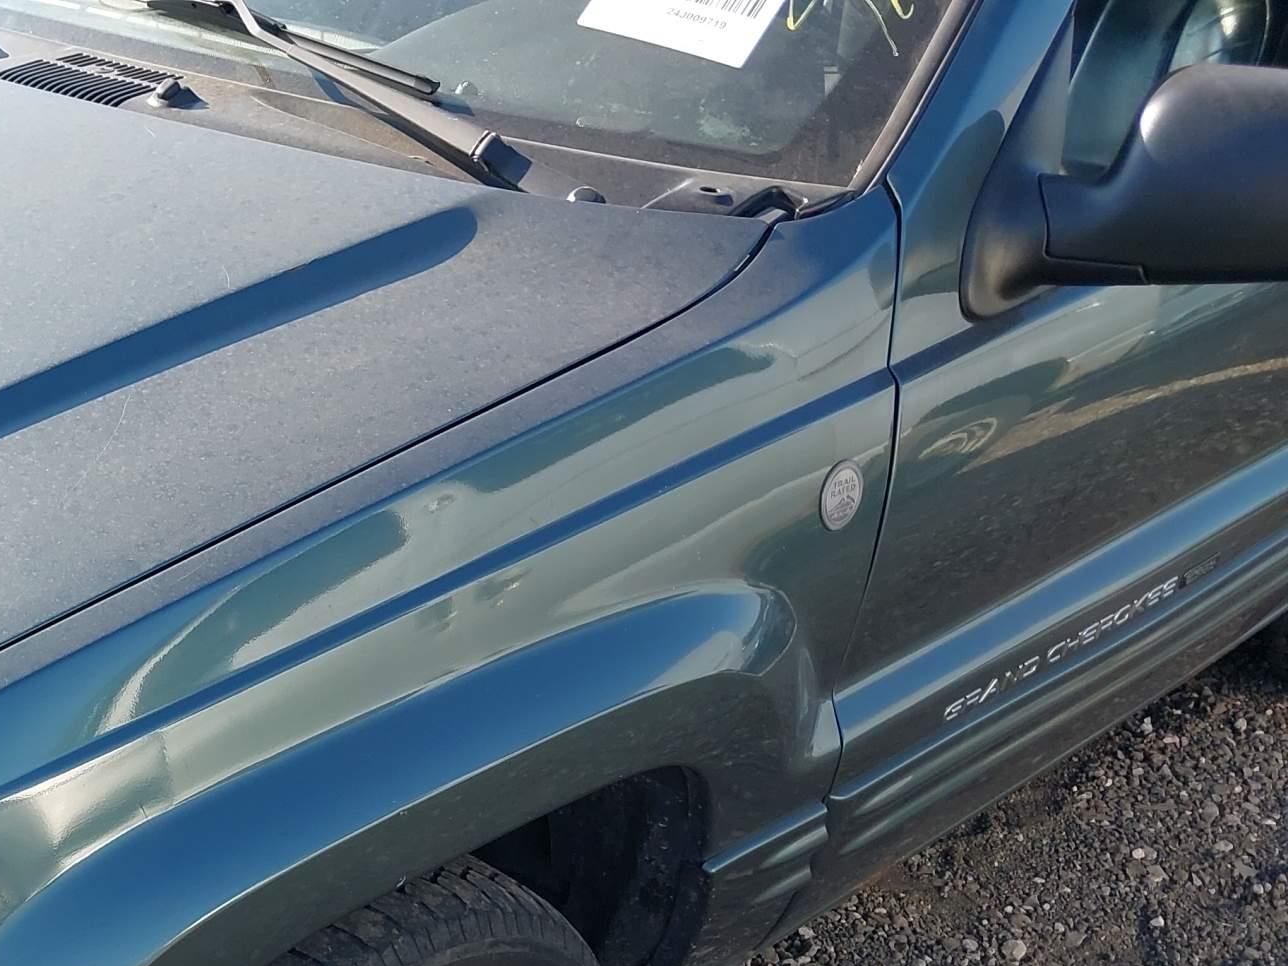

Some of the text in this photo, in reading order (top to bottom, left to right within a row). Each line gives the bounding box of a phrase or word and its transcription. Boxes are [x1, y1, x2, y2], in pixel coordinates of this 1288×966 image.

[833, 475, 856, 490] TRAIL
[943, 575, 1179, 721] GRAND CHEROKEE
